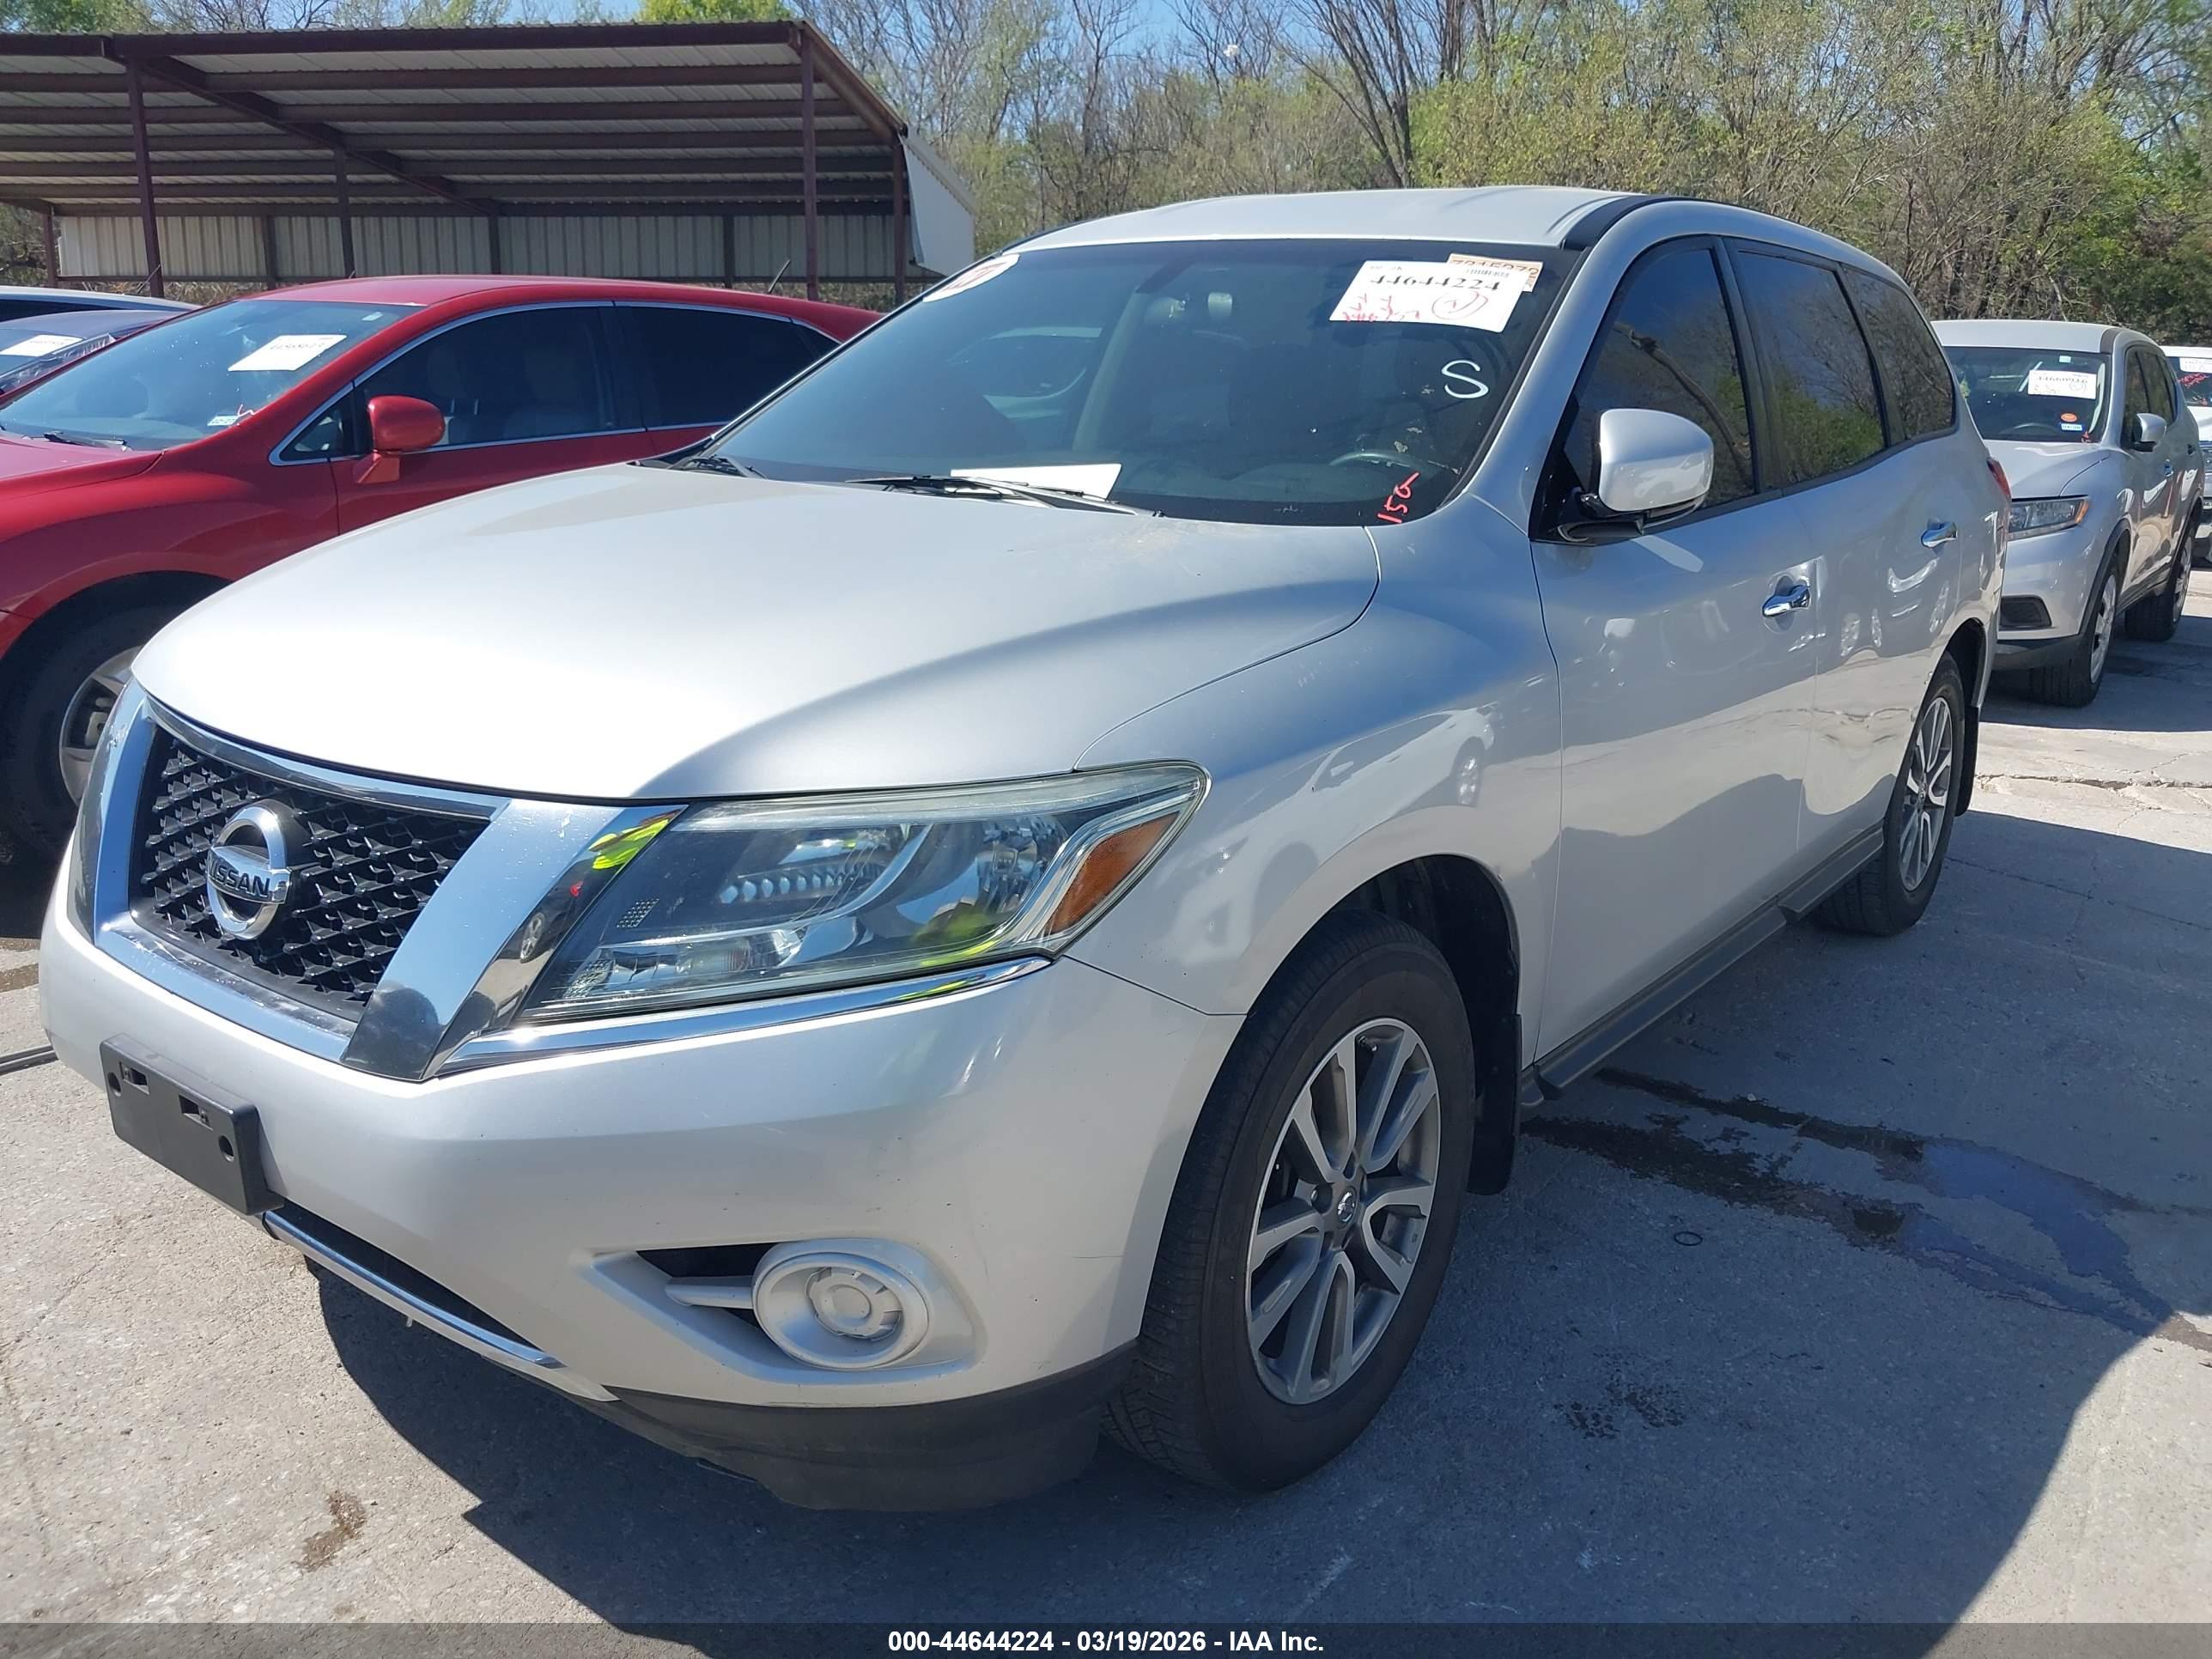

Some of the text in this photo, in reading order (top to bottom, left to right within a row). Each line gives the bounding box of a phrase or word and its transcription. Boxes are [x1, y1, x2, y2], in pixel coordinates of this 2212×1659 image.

[1370, 275, 1501, 290] 44644224
[1441, 359, 1490, 399] S
[210, 859, 270, 897] NISSAN
